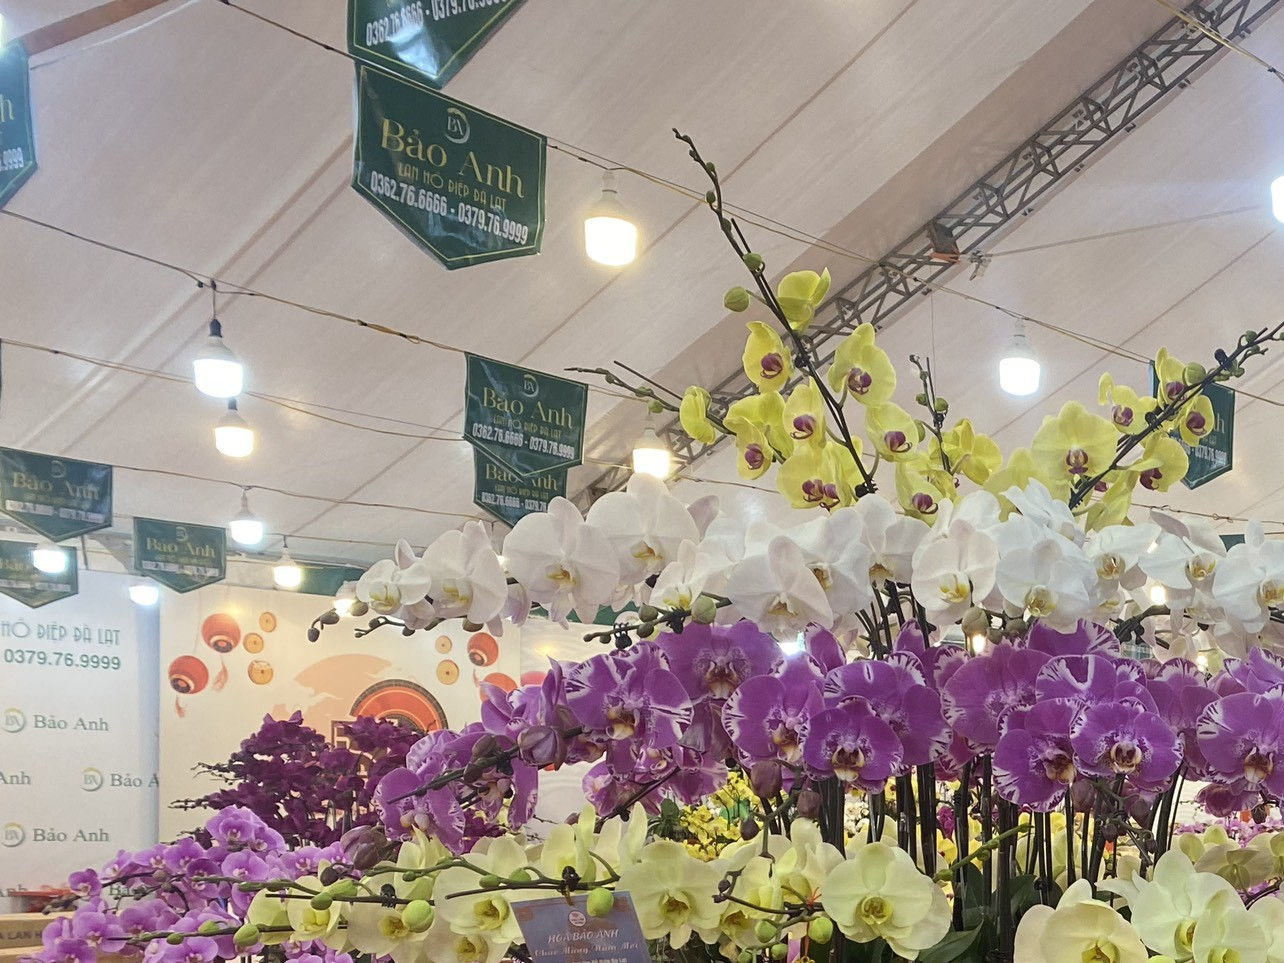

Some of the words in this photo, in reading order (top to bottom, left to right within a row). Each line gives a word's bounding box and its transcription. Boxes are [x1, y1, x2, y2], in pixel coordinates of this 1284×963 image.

[381, 117, 448, 168] Bảo
[458, 151, 525, 199] Anh
[370, 170, 448, 217] 0362.76.6666
[458, 202, 529, 245] 0379.76.9999
[531, 400, 573, 429] Anh
[472, 422, 524, 448] 0362.76.6666
[529, 436, 575, 461] 0379.76.9999
[37, 621, 67, 644] ĐIỆP
[73, 623, 93, 643] ĐÀ
[98, 627, 121, 648] LẠT
[4, 649, 121, 670] 0379.76.9999
[33, 714, 68, 730] Bảo
[73, 717, 110, 732] Anh
[110, 773, 143, 787] Bảo
[33, 828, 68, 842] Bảo
[72, 829, 110, 842] Anh
[596, 928, 619, 939] ANH
